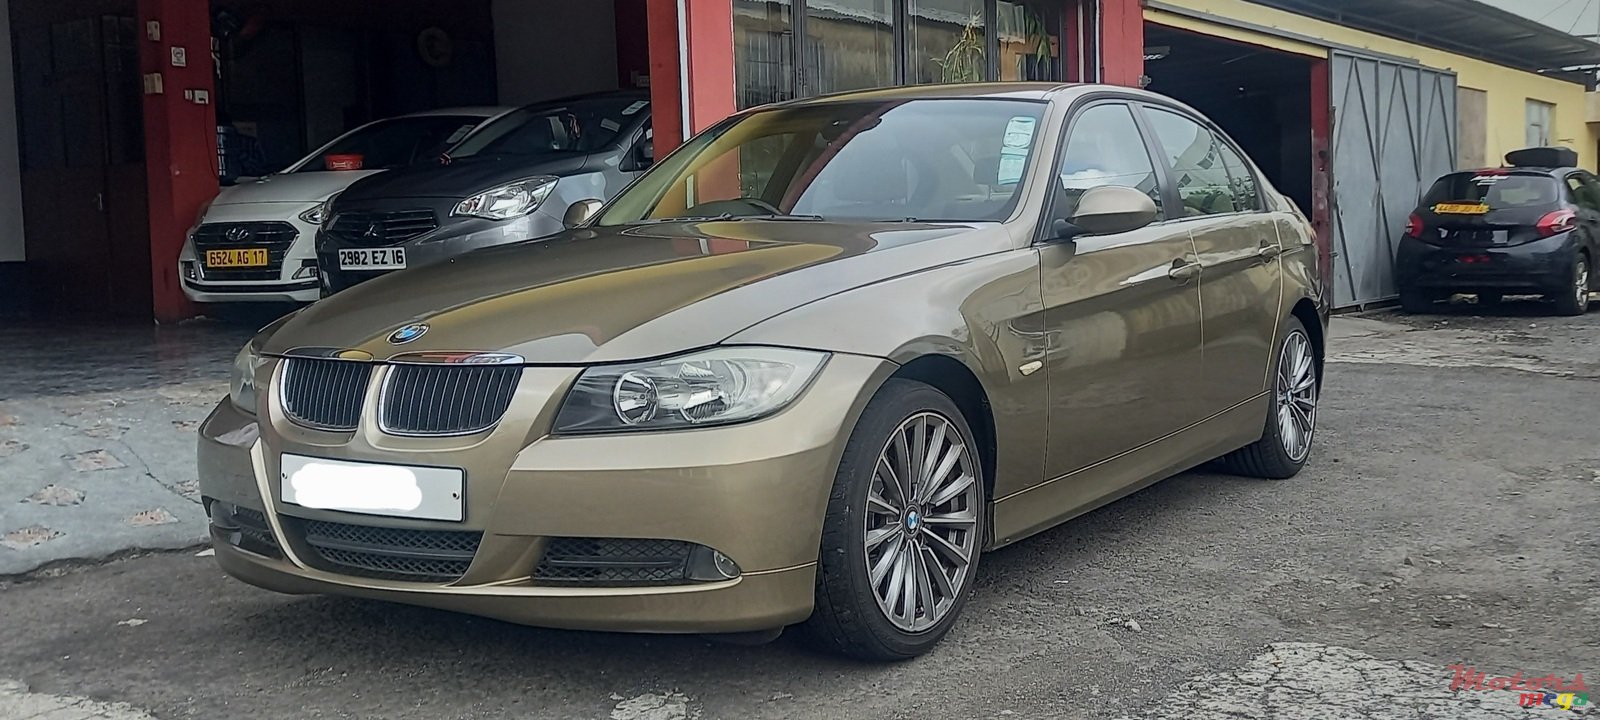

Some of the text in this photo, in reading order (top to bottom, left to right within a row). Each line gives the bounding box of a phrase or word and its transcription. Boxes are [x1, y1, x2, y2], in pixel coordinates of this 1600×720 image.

[210, 250, 264, 265] 6524 AG 17
[340, 249, 404, 266] 2982 EZ 16
